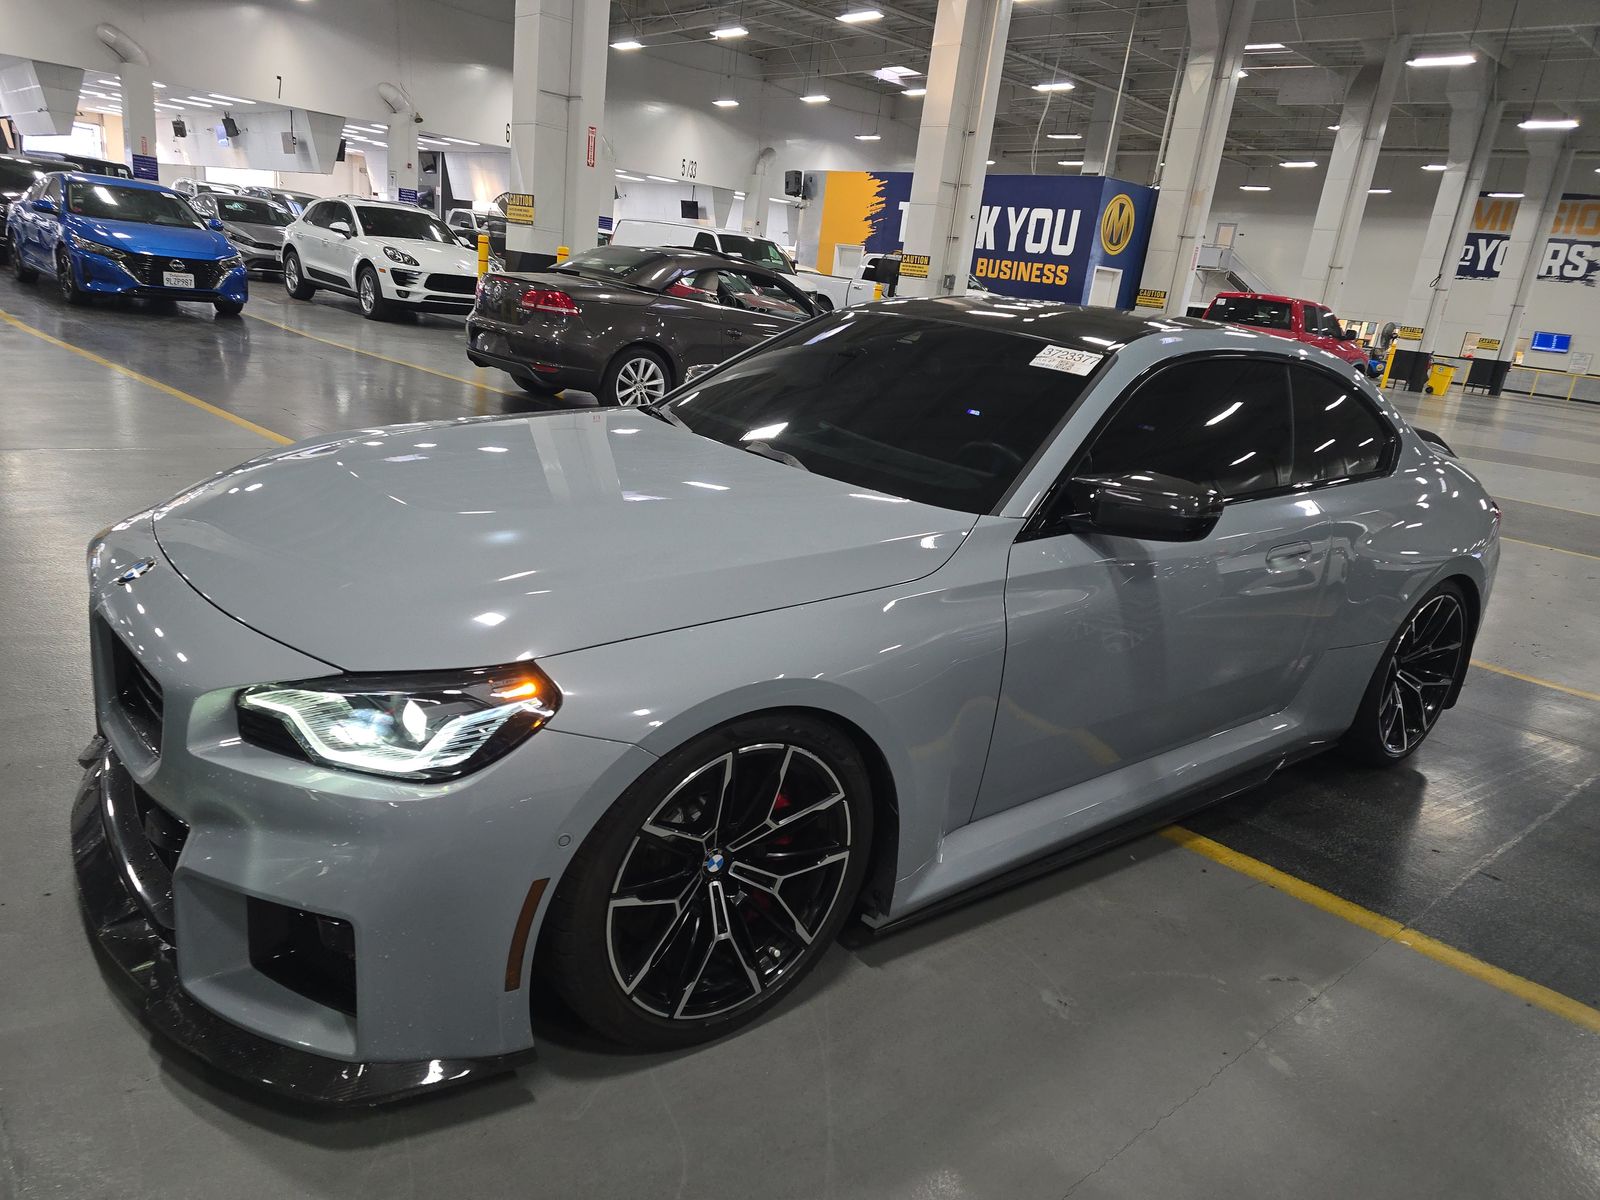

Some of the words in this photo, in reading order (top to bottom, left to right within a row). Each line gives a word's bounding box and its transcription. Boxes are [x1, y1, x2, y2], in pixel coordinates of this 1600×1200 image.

[505, 122, 511, 143] 6
[509, 194, 533, 207] CAUTION
[1007, 206, 1082, 257] YOU
[902, 254, 929, 265] CAUTION
[975, 257, 1070, 286] BUSINESS
[1139, 289, 1166, 298] CAUTION
[1042, 347, 1101, 365] 3723377
